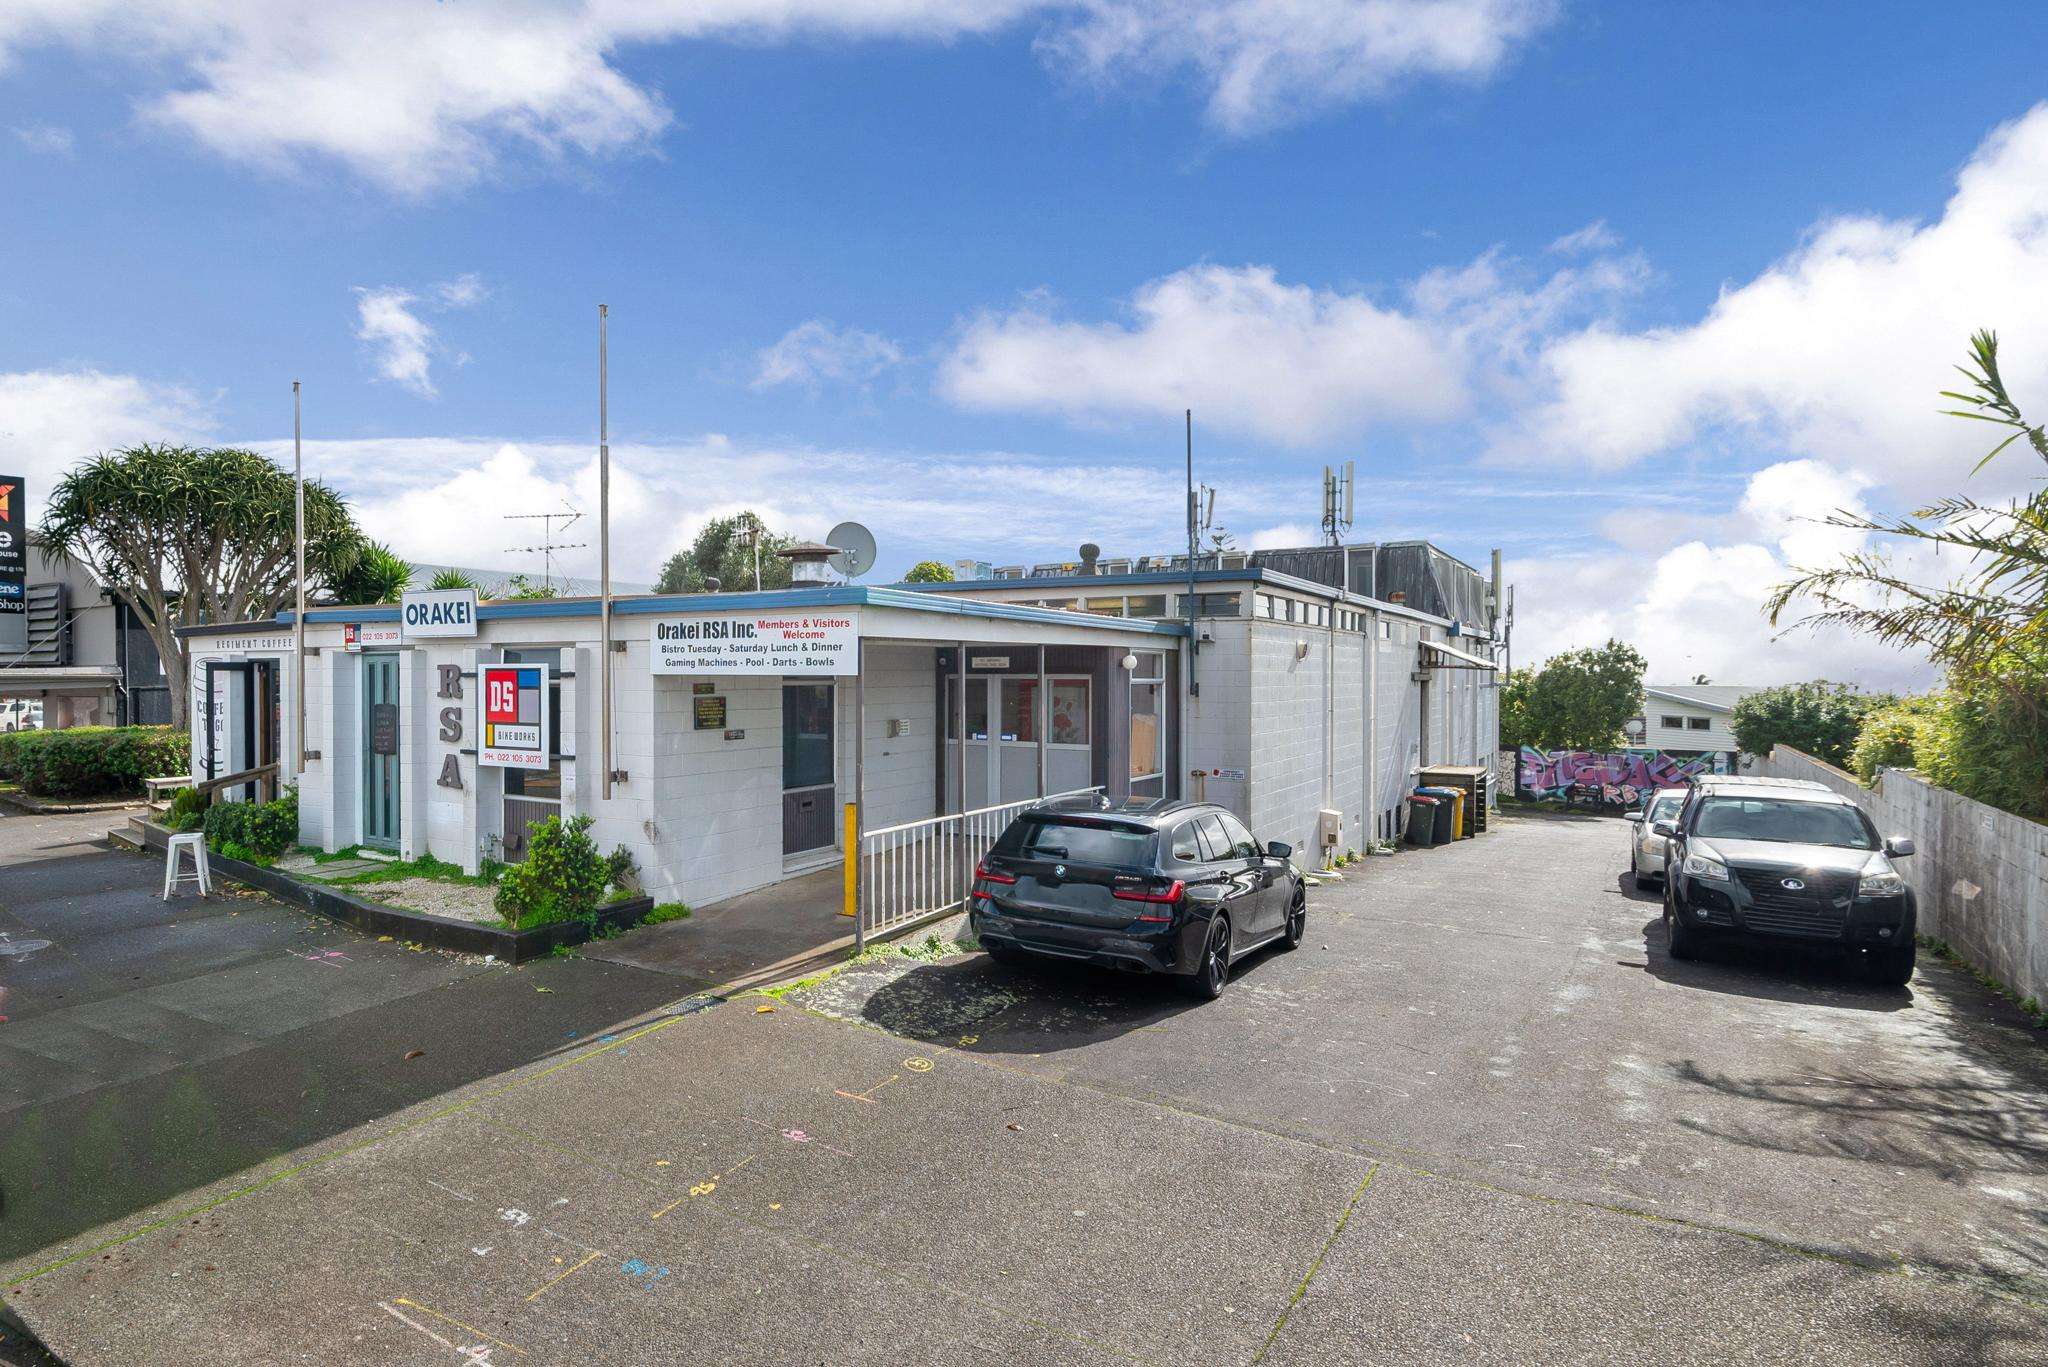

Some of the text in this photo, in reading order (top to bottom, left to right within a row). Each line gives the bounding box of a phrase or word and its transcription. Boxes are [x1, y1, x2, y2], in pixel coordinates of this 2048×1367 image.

[406, 601, 471, 626] ORAKEI
[757, 618, 850, 629] Members & Visitors
[657, 620, 758, 640] Orakei RSA Inc.
[783, 630, 825, 639] Welcome
[216, 638, 292, 649] REGIMENT COFFEE
[661, 645, 685, 654] Bistro
[688, 645, 722, 655] Tuesday
[729, 643, 768, 655] Saturday
[771, 643, 798, 652] Lunch
[801, 642, 808, 652] &
[811, 642, 843, 652] Dinner
[665, 658, 696, 668] Gaming
[698, 658, 738, 667] Machines
[745, 658, 765, 667] Pool
[772, 657, 798, 667] Darts
[805, 657, 835, 666] Bowls
[490, 681, 514, 713] DS
[497, 753, 509, 761] 022
[512, 753, 523, 763] 105
[525, 754, 542, 764] 3073
